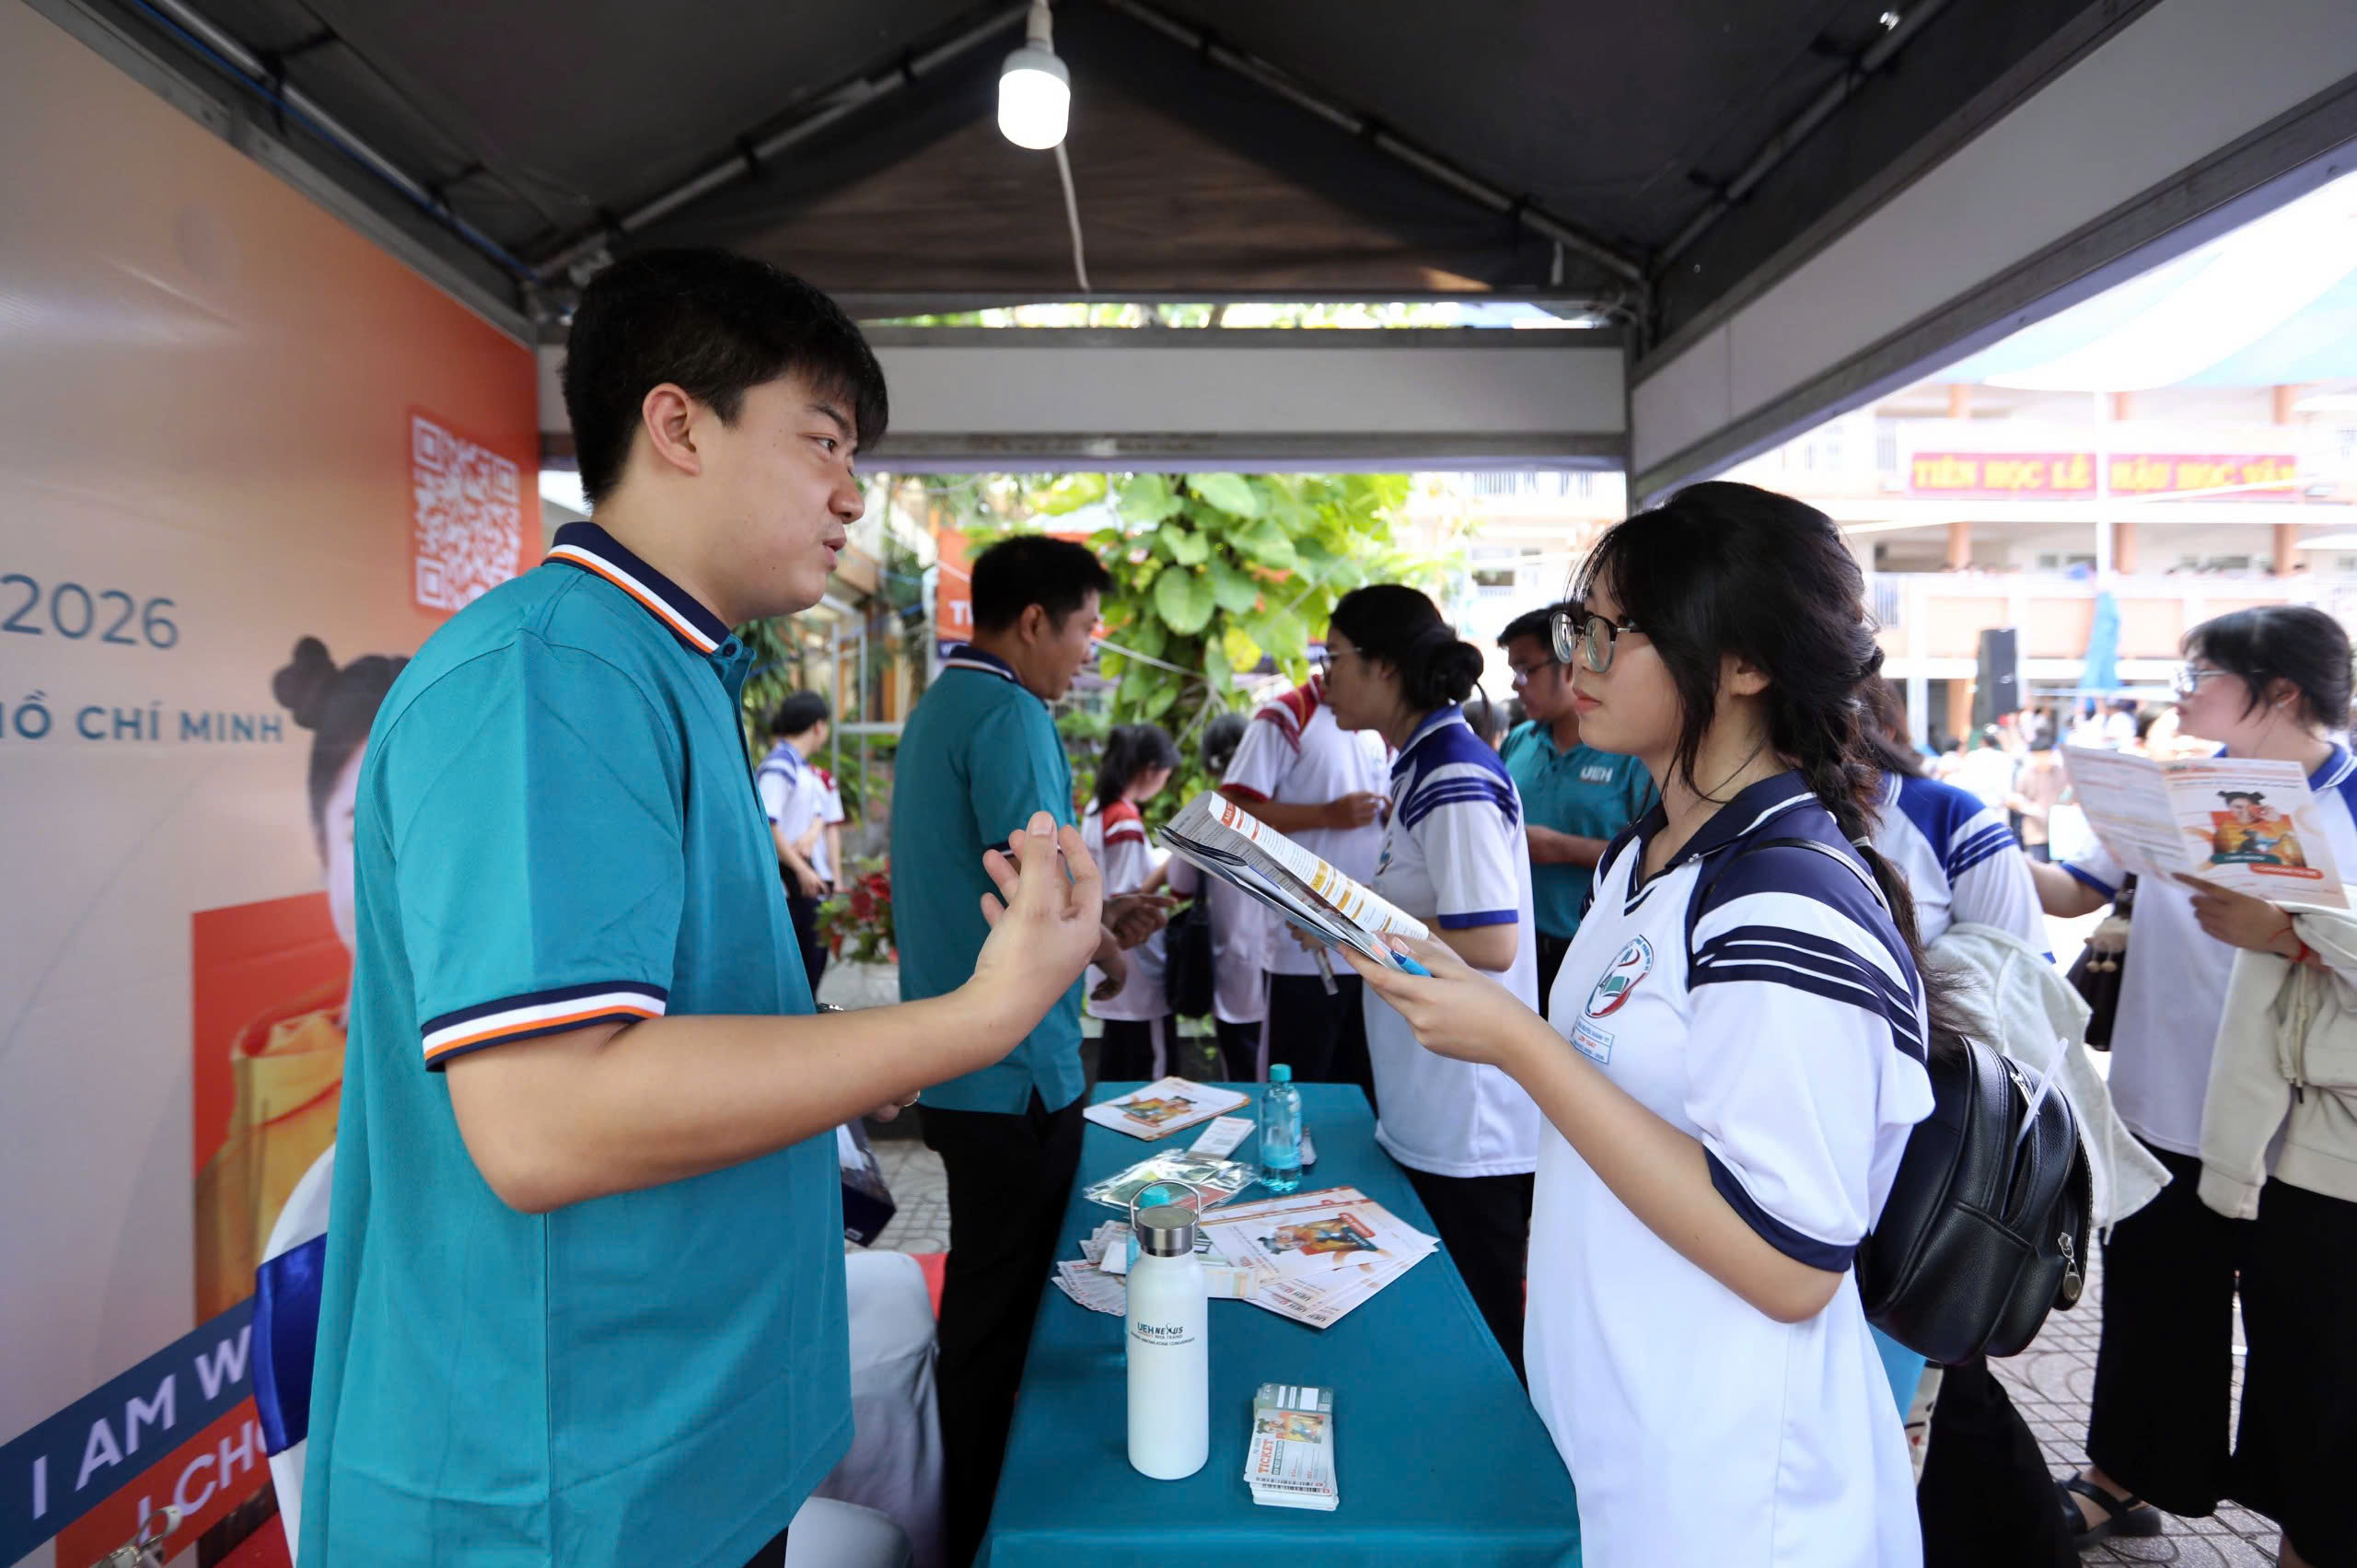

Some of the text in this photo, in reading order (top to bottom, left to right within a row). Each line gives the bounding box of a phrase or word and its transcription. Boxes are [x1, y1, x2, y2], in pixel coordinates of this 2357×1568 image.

[1, 573, 180, 649] 2026
[75, 700, 162, 741] CHÍ
[179, 711, 284, 743] MINH
[1580, 765, 1614, 782] UEH
[1137, 1321, 1154, 1335] UEH
[31, 1455, 48, 1520] I
[75, 1373, 178, 1492] AM
[1258, 1439, 1274, 1473] TICKET
